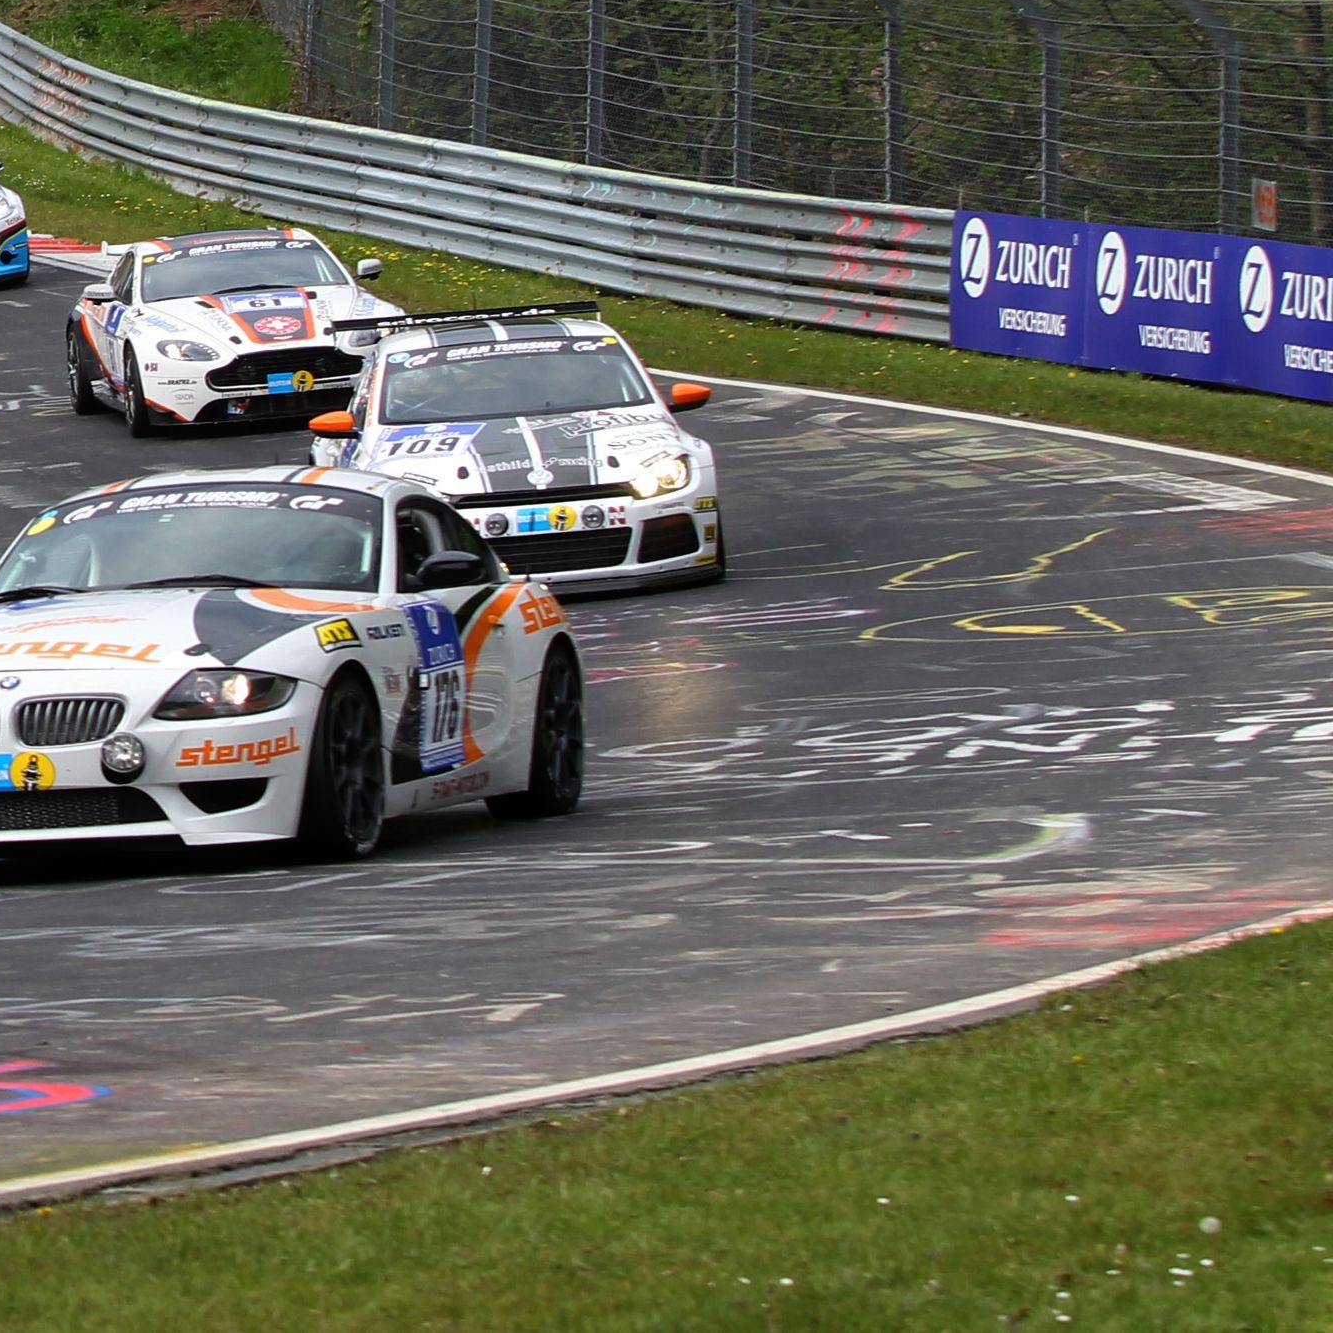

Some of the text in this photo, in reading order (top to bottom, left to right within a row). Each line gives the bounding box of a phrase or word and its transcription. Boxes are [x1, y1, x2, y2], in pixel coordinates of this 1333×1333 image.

[189, 244, 223, 255] GRAN
[224, 241, 278, 250] TURISMO
[994, 240, 1073, 290] ZURICH
[1133, 254, 1213, 305] ZURICH
[376, 307, 556, 327] scirocco-r.de
[998, 306, 1066, 338] VERSICHERUNG
[446, 345, 491, 358] GRAN
[493, 340, 563, 352] TURISMO
[1138, 324, 1211, 355] VERSICHERUNG
[388, 436, 461, 457] 109
[120, 493, 183, 510] GRAN
[183, 491, 282, 504] TURISMO
[366, 623, 406, 641] FALKEN
[175, 726, 301, 768] stengel
